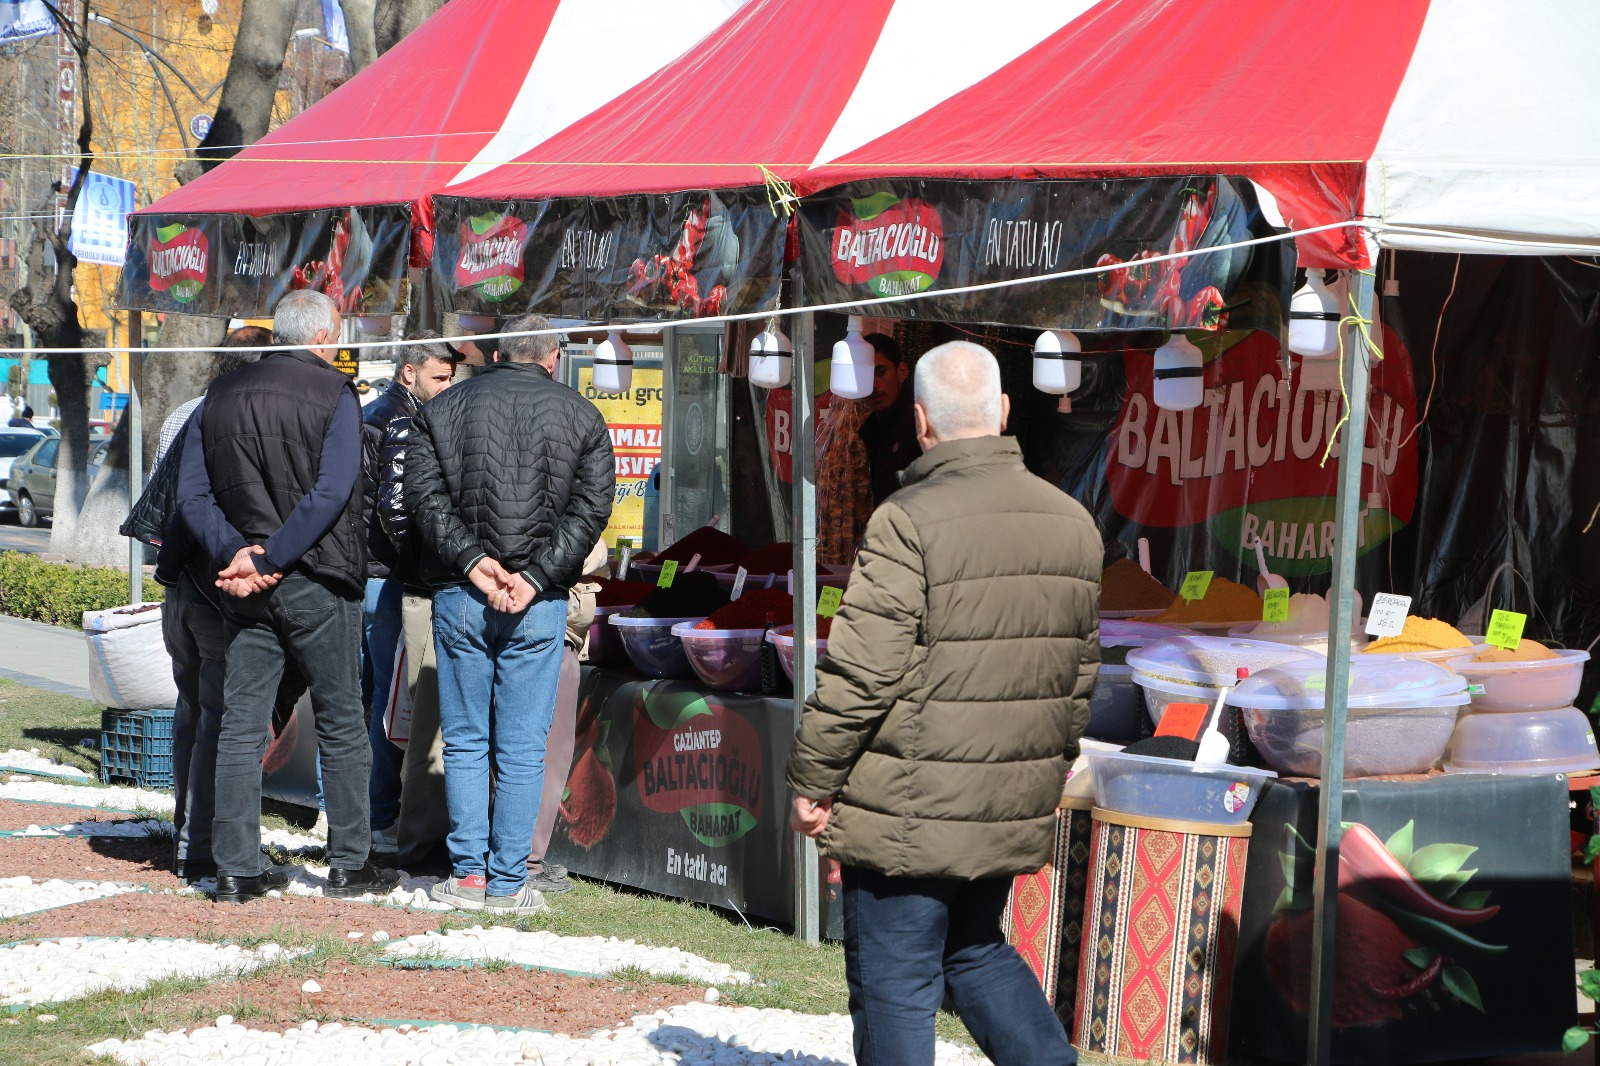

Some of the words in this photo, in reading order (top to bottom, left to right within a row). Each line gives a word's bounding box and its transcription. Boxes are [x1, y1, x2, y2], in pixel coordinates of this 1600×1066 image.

[837, 215, 940, 268] BALTACIOĞLU
[985, 216, 1003, 267] EN
[1005, 218, 1038, 270] TATLI
[879, 275, 922, 296] BAHARAT
[1241, 508, 1368, 559] BAHART
[673, 725, 722, 752] GAZİANTEP
[644, 748, 761, 808] BALTACIOĞLU
[689, 809, 742, 838] BAHARAT
[667, 847, 681, 876] En
[684, 852, 708, 882] tatlı
[709, 864, 728, 887] acı
